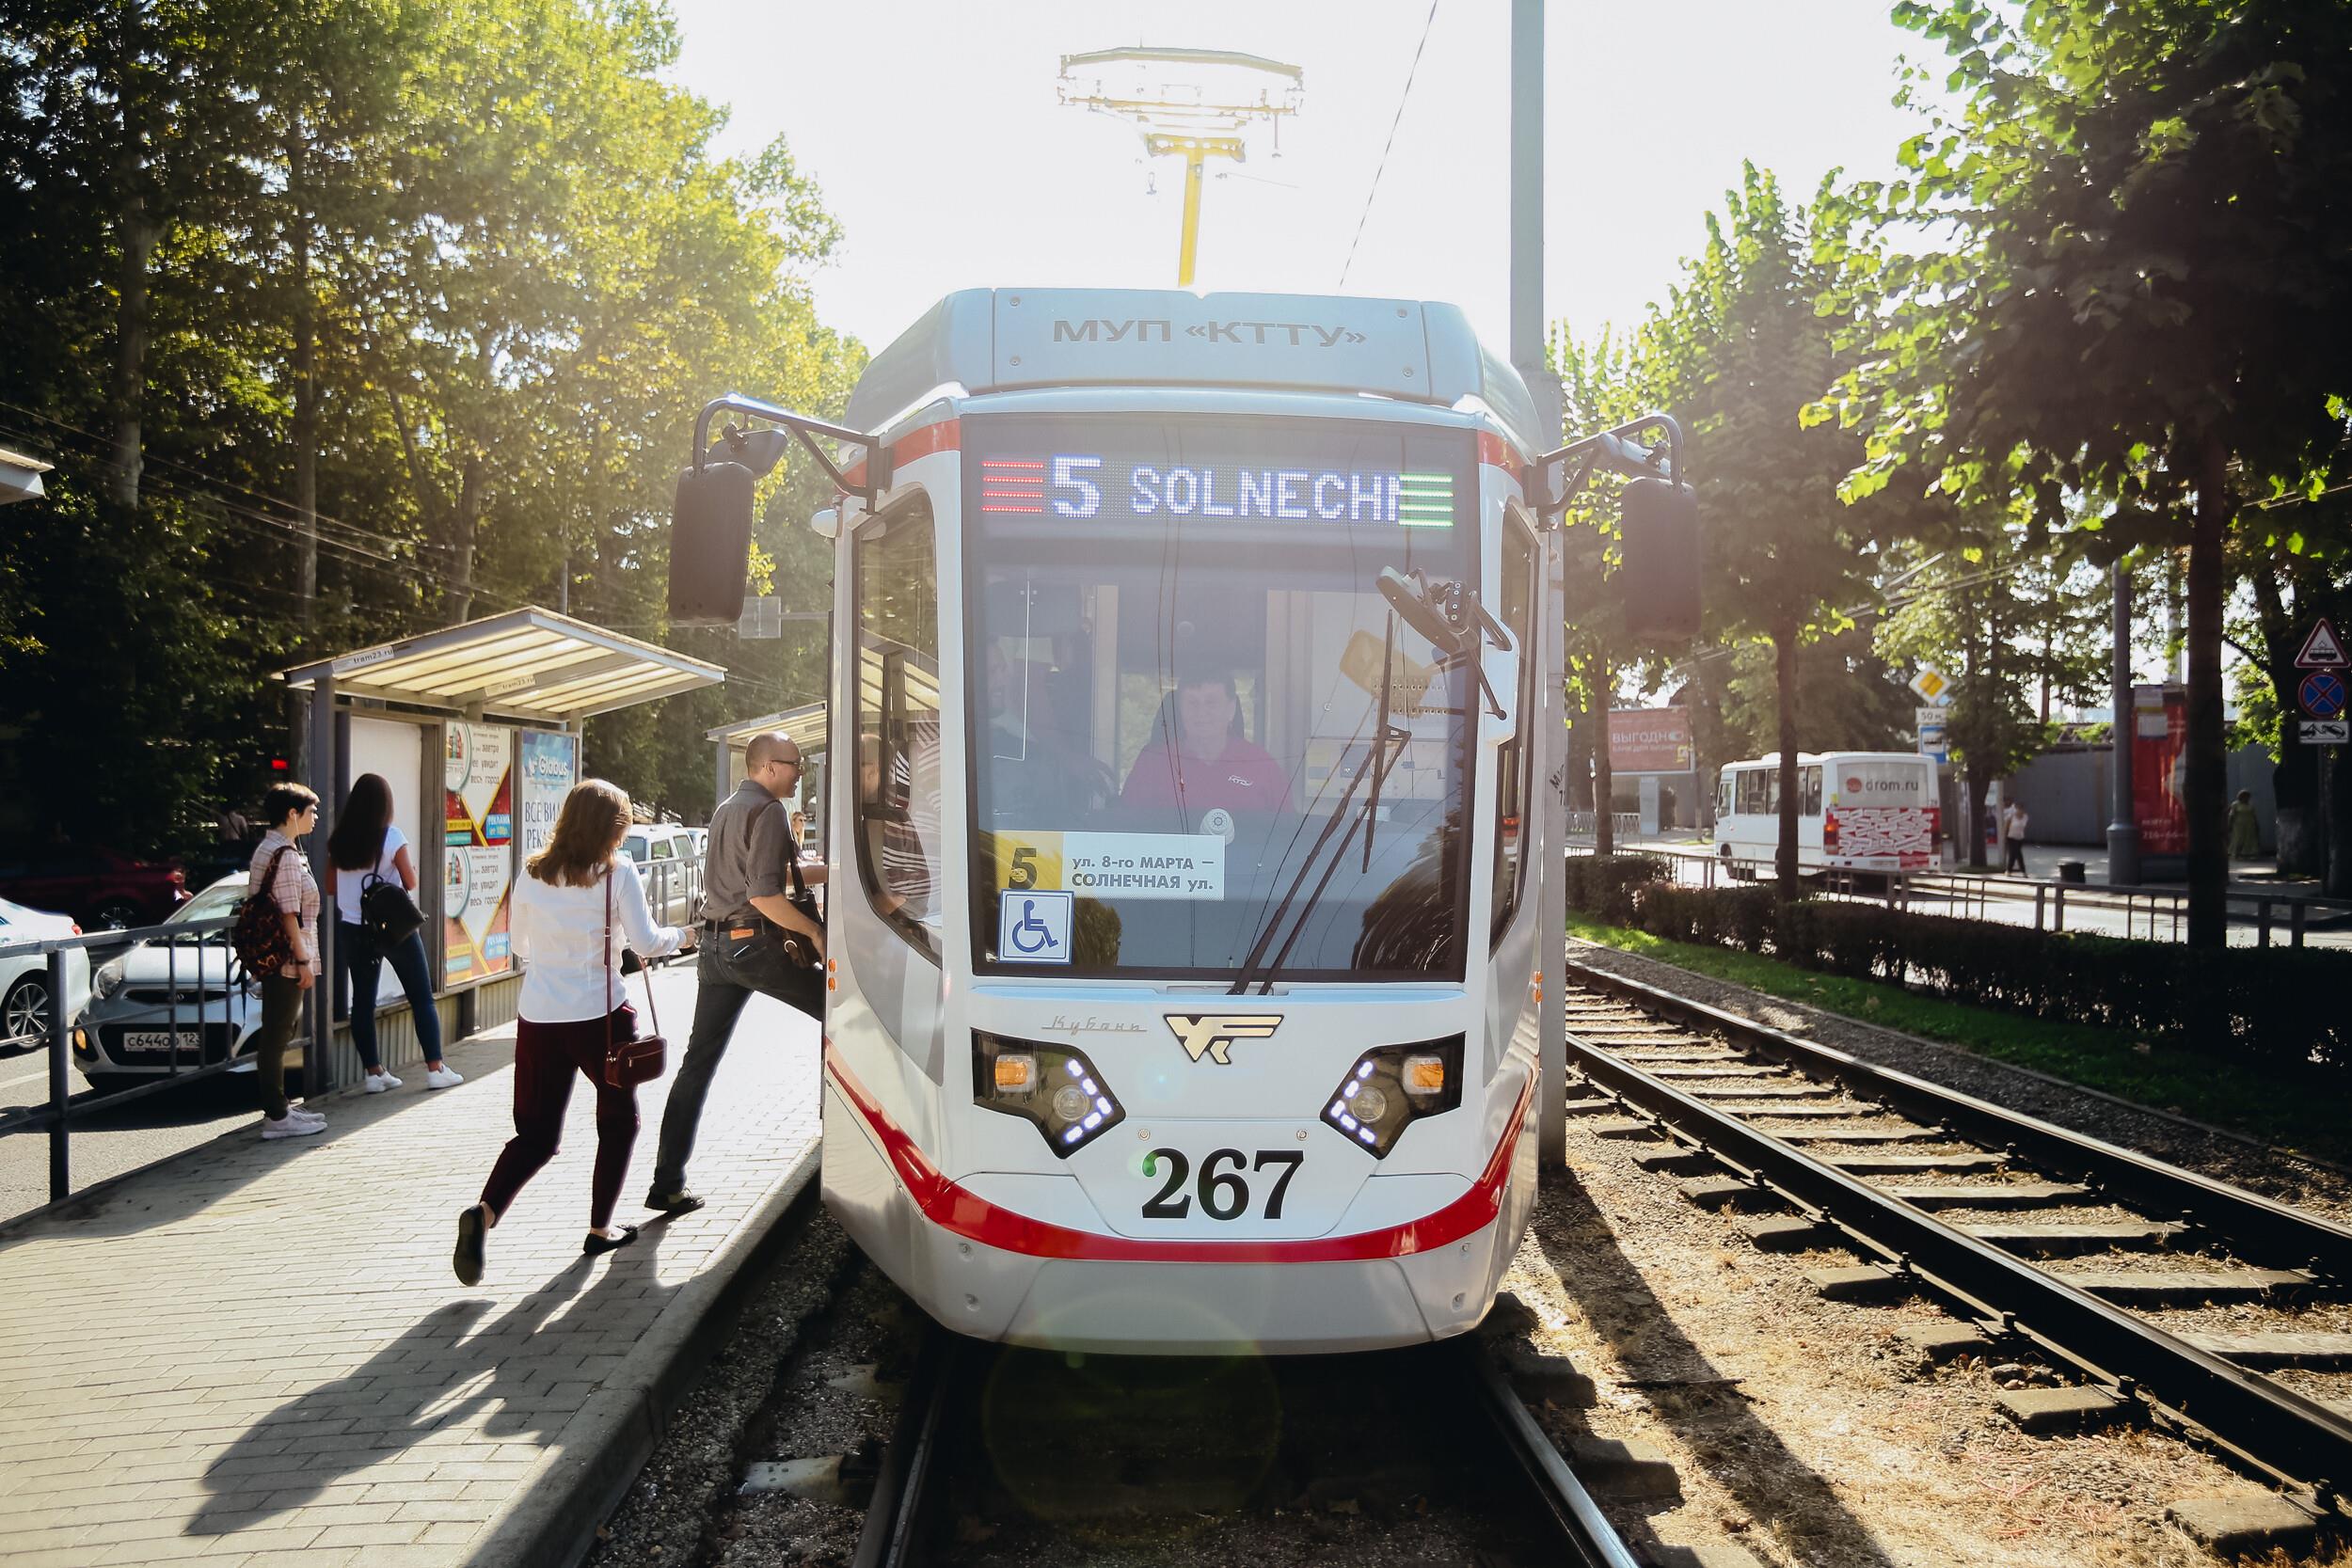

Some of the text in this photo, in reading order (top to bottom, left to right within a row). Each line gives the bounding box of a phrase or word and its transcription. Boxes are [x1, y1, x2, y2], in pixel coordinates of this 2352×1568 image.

[1053, 319, 1367, 347] МУП «КТТУ»
[1053, 456, 1102, 518] 5
[539, 755, 568, 778] Globus
[1866, 779, 1919, 791] drom.ru
[525, 801, 542, 823] ВСЕ
[1008, 847, 1038, 890] 5
[1072, 857, 1096, 870] ул.
[1102, 855, 1135, 868] 8-го
[1139, 856, 1194, 870] МАРТА
[1072, 873, 1214, 892] СОЛНЕЧНАЯ ул.
[1141, 1148, 1305, 1221] 267
